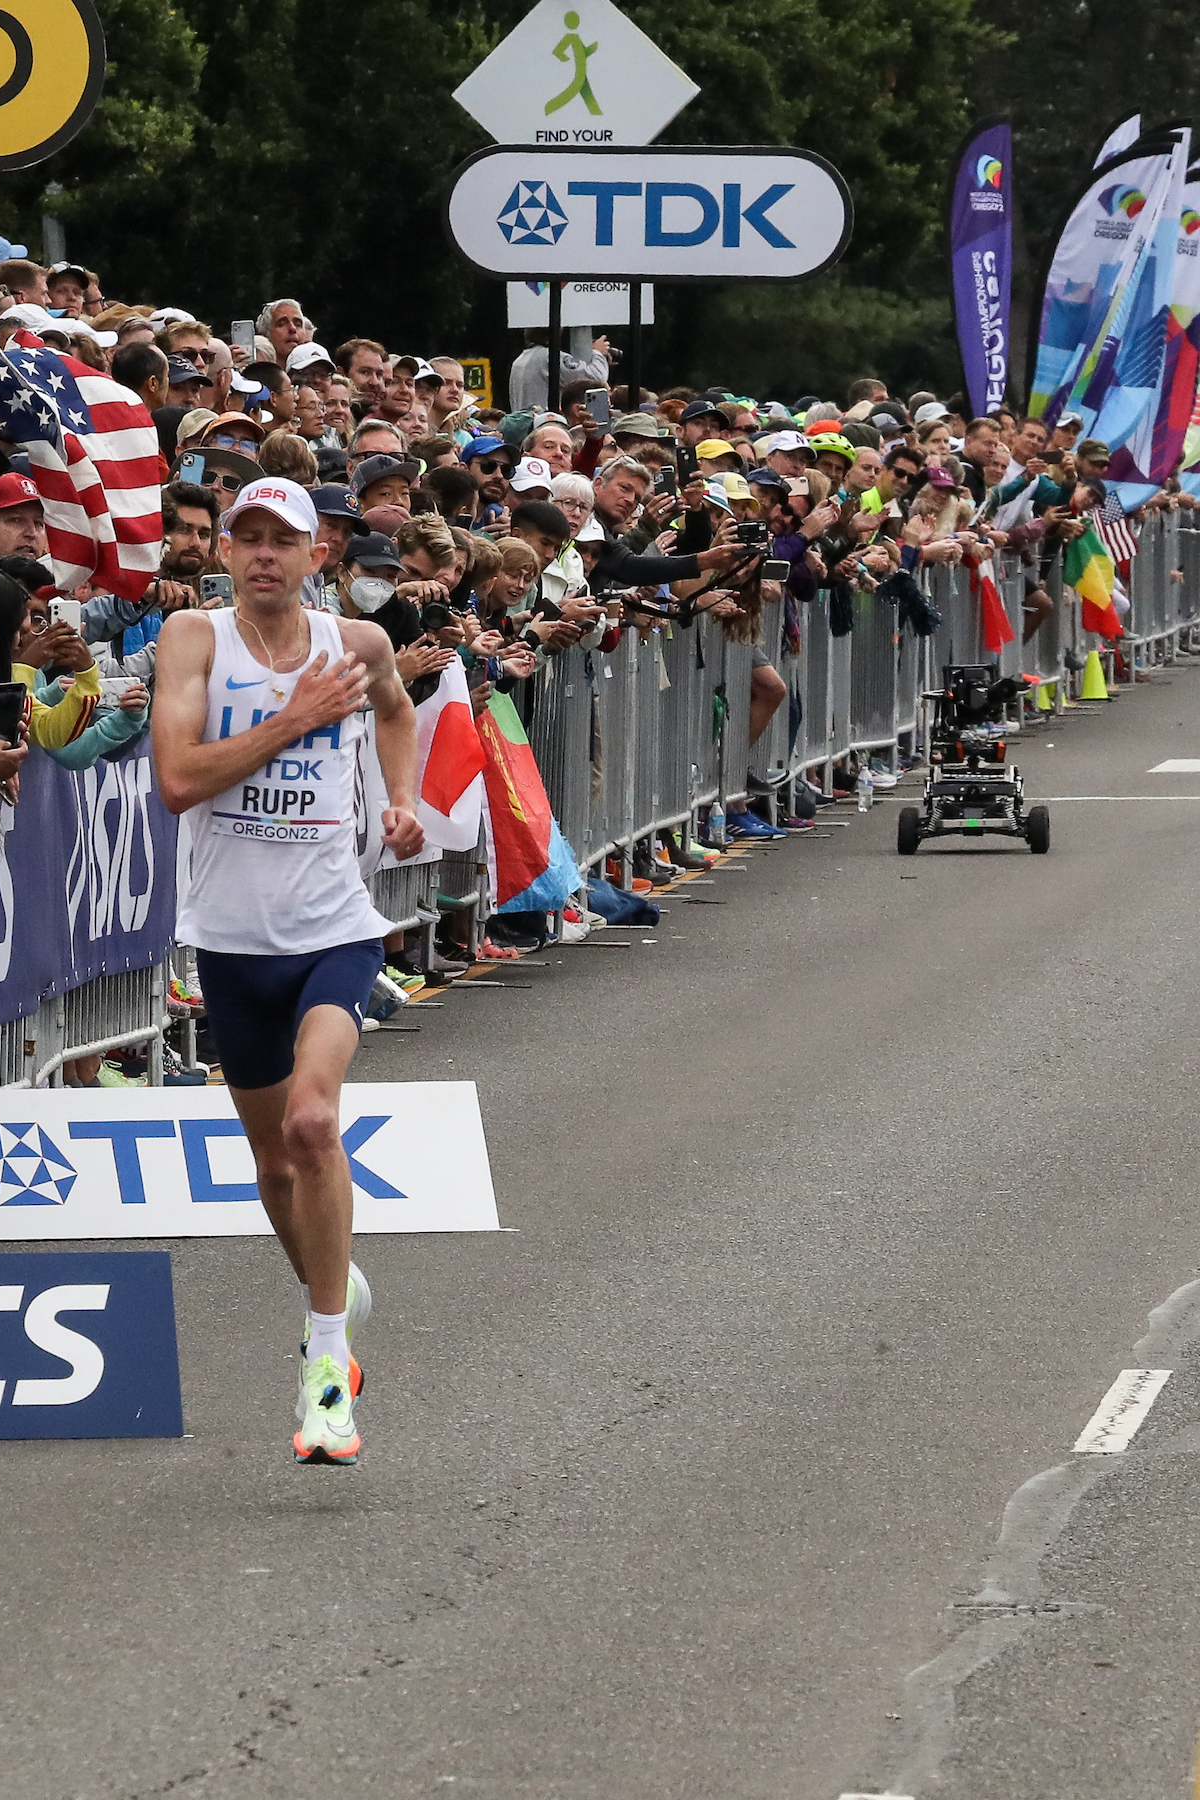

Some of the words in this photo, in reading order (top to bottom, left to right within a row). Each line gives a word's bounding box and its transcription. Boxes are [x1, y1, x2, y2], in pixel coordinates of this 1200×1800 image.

[536, 130, 568, 142] FIND
[573, 130, 613, 142] YOUR
[567, 181, 798, 249] TDK
[574, 283, 629, 293] OREGON2
[247, 487, 287, 502] USA
[266, 759, 323, 781] TDK
[242, 785, 316, 816] RUPP
[233, 822, 319, 841] OREGON22
